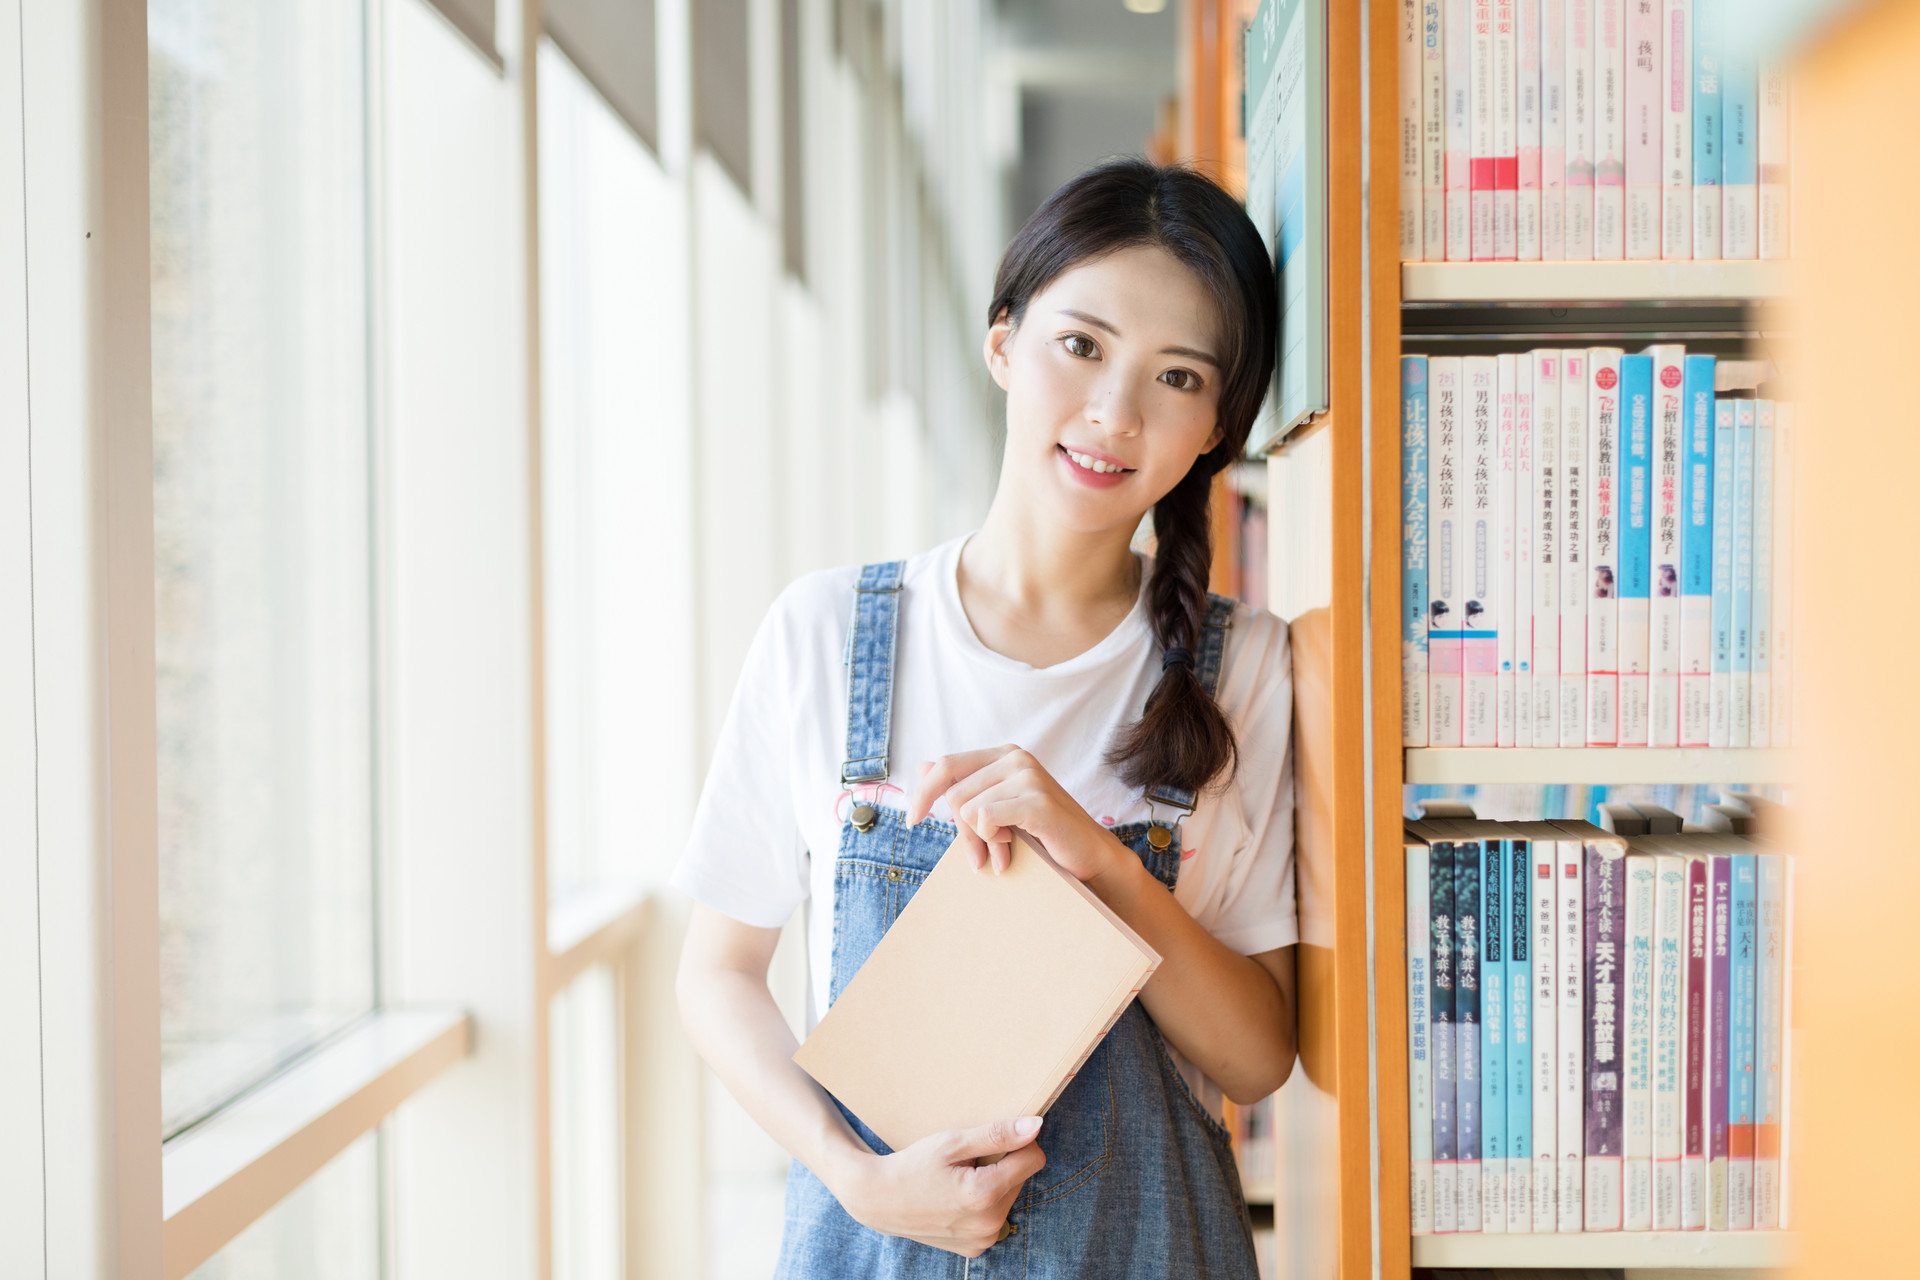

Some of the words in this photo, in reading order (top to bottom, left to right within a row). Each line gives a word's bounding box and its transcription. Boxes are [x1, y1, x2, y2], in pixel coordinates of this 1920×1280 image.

[1404, 399, 1426, 570] 让孩子学会吃苦
[1543, 467, 1553, 563] 隔代教育的成功之道
[1569, 467, 1579, 563] 隔代教育的成功之道
[1435, 914, 1450, 988] 教子博弈论
[1460, 915, 1476, 988] 教子博弈论
[1411, 957, 1426, 1060] 怎样使孩子更聪明
